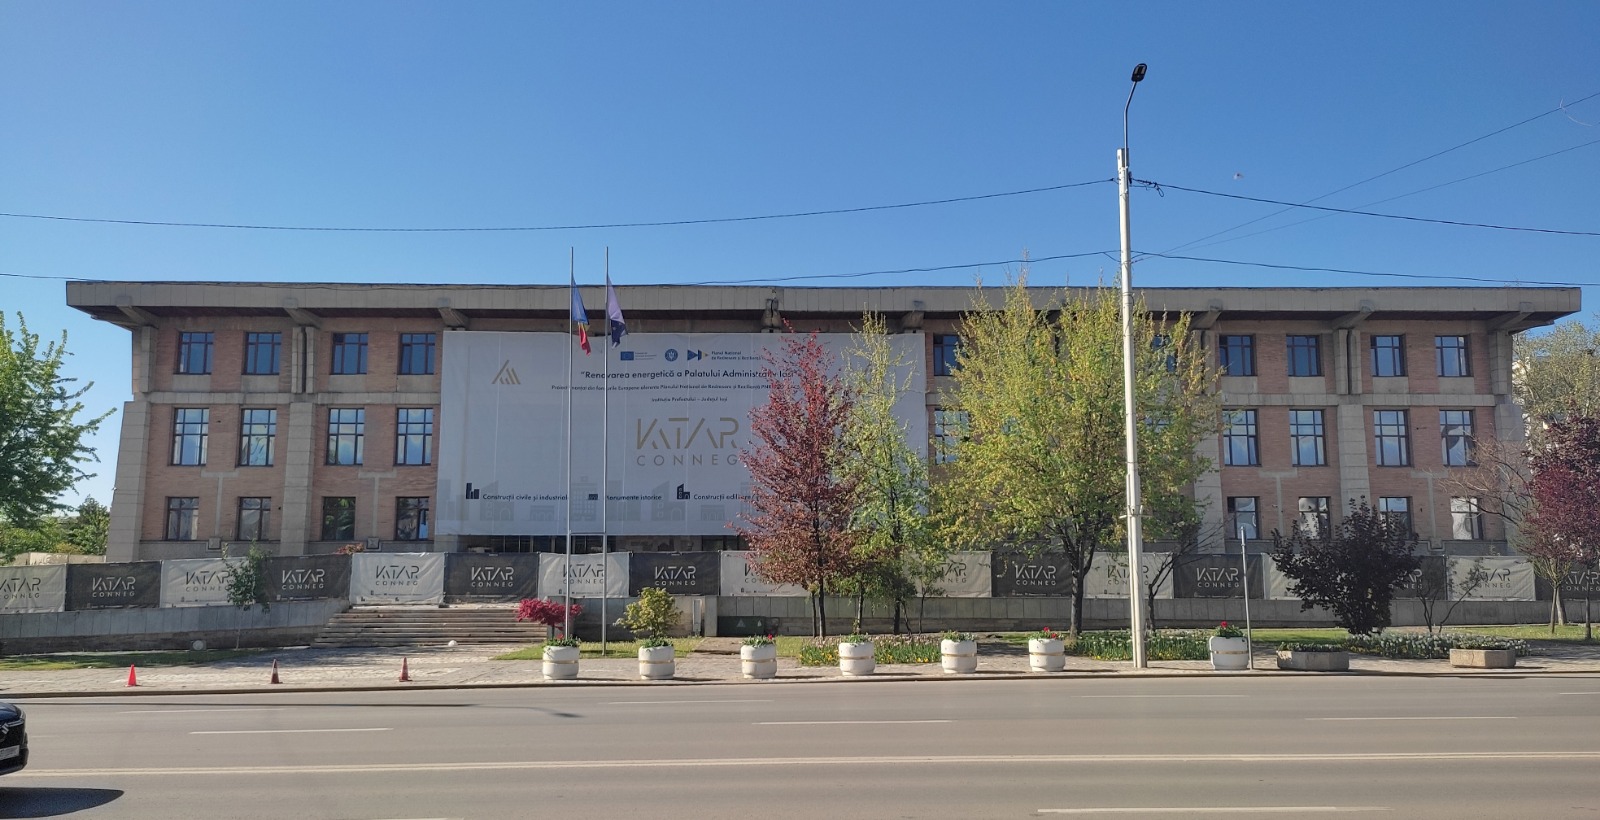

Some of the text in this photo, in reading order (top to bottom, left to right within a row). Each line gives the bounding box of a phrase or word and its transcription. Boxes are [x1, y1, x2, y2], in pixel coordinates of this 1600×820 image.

[632, 369, 675, 380] energetică
[685, 369, 721, 378] Palatului
[636, 454, 738, 466] CONNEG
